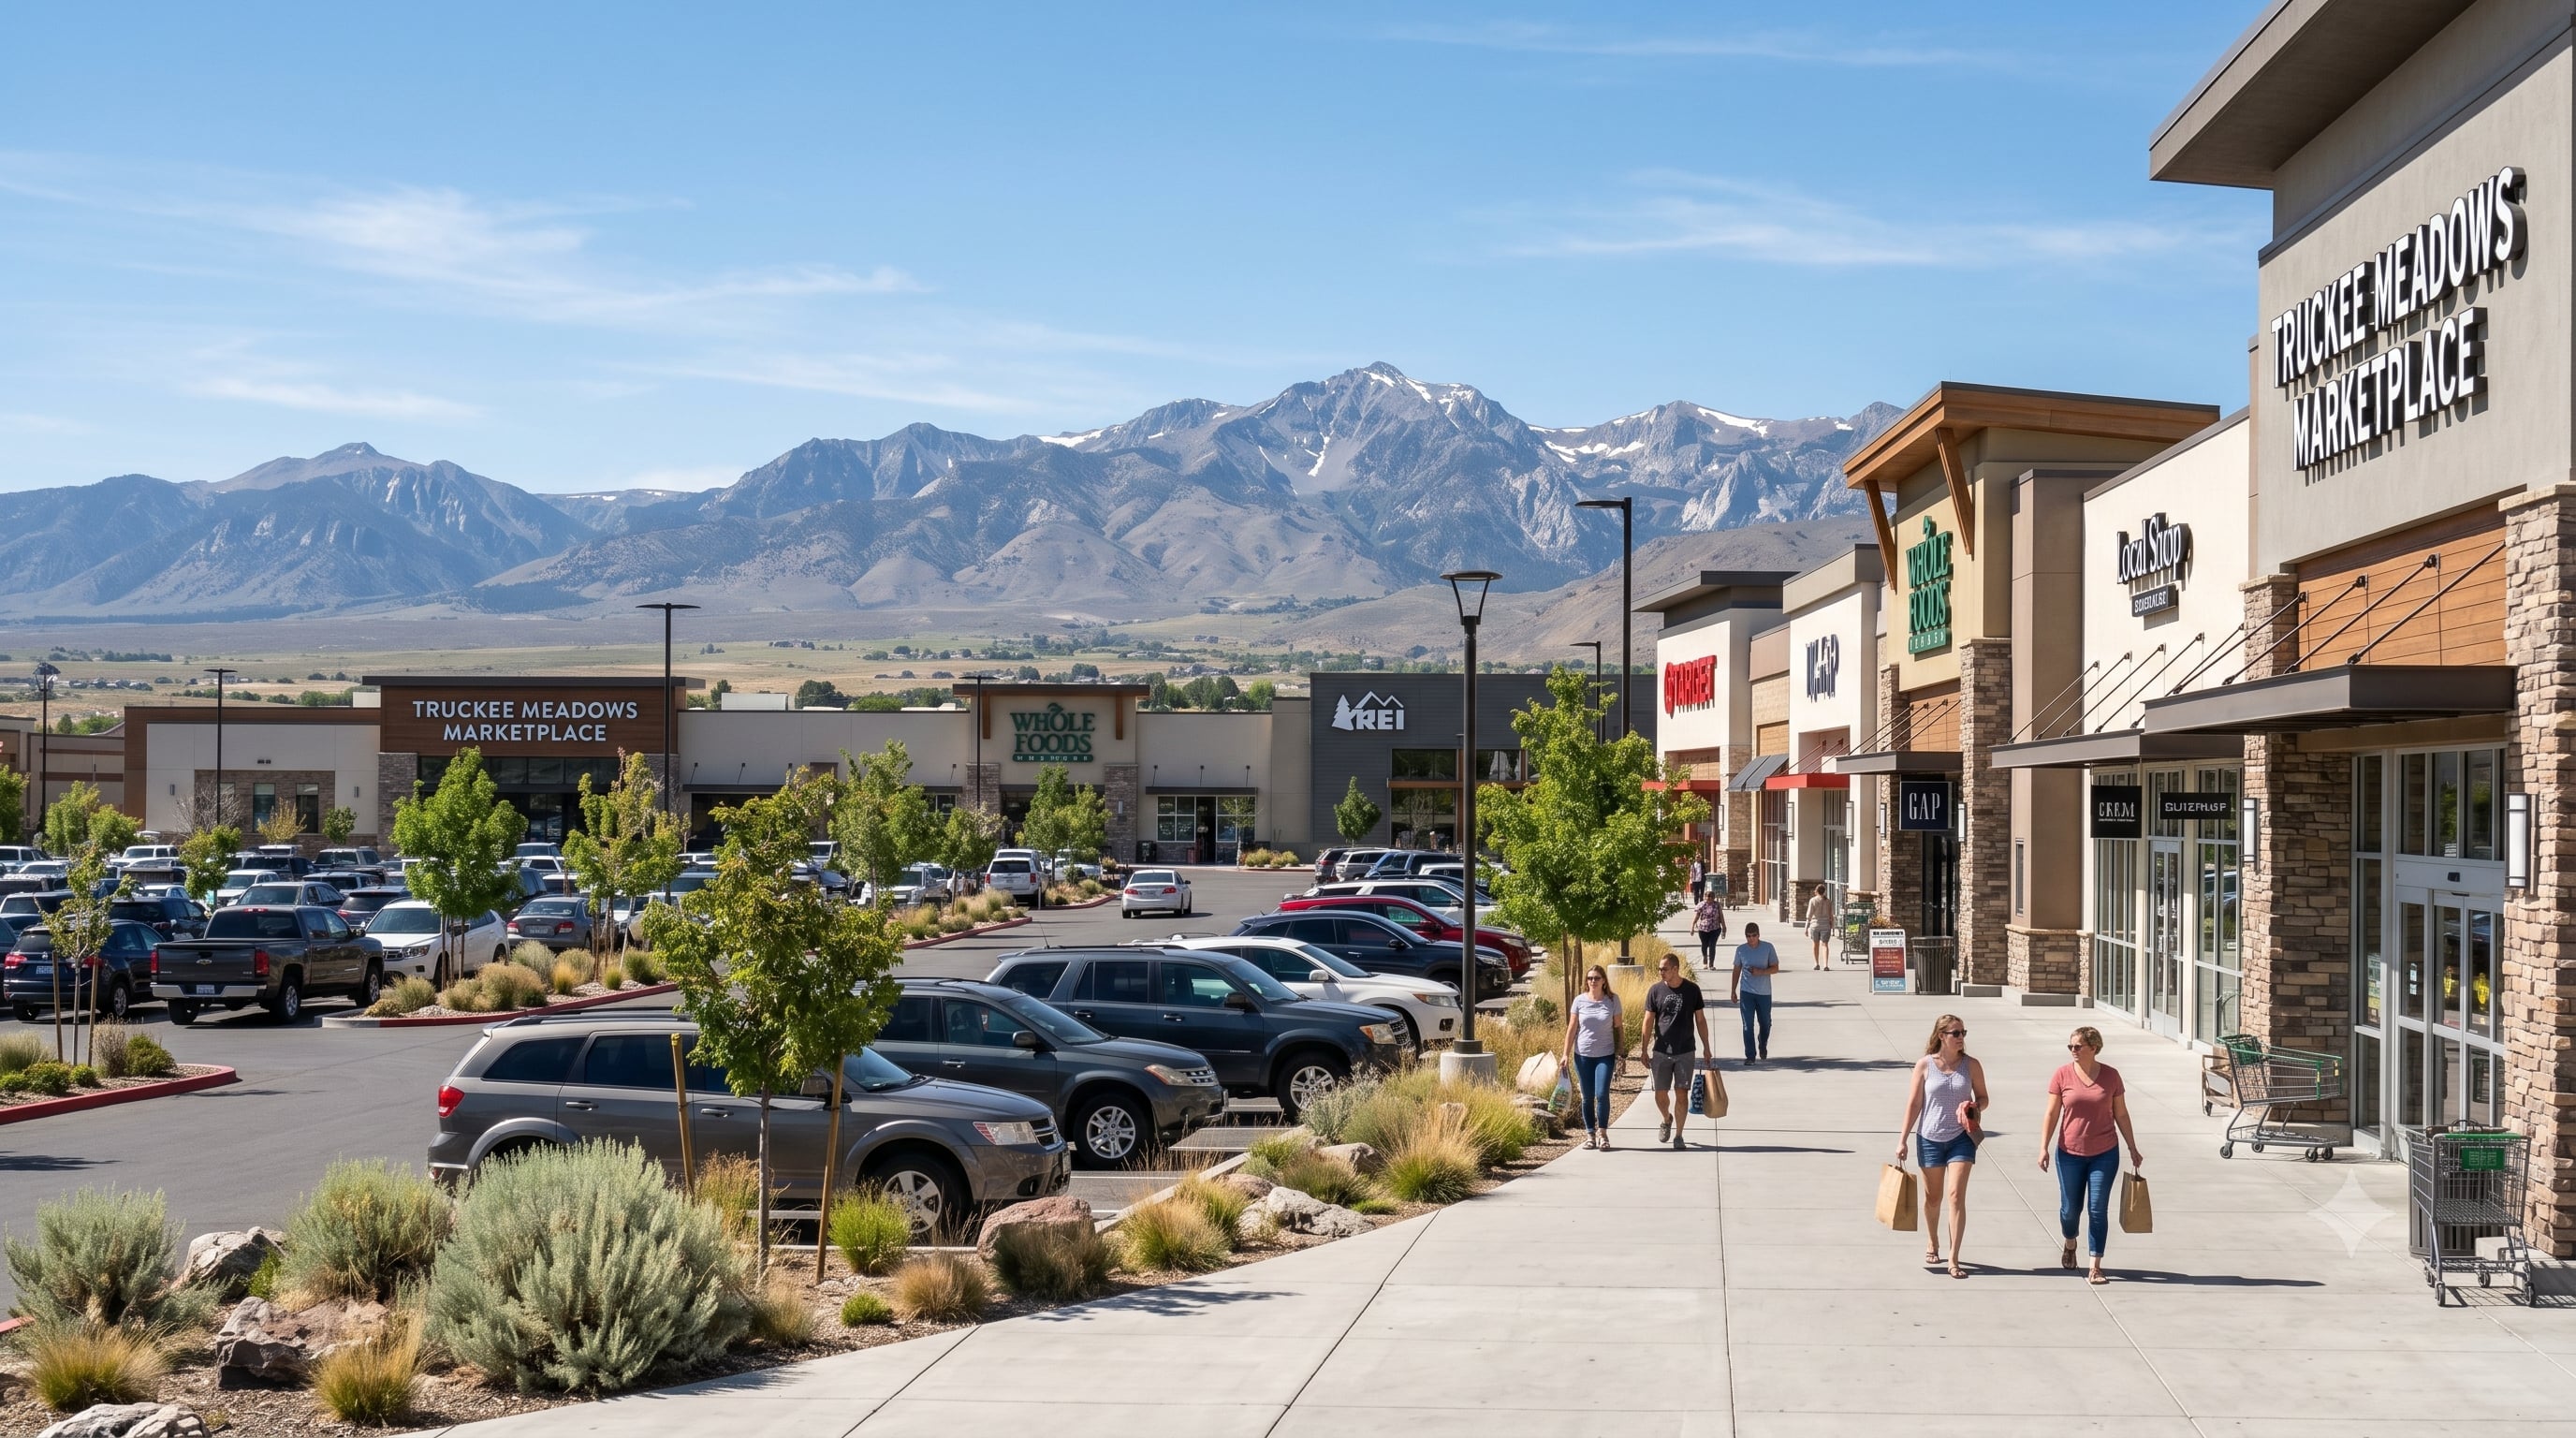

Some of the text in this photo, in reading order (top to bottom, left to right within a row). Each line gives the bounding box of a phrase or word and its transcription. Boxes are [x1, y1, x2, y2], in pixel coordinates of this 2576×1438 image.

[2270, 167, 2523, 389] TRUCKEE MEADOWS
[2293, 307, 2483, 472] MARKETPLACE
[1906, 532, 1950, 590] WHOLE
[1909, 581, 1948, 635] FOODS
[1673, 655, 1716, 708] TARGET
[412, 700, 638, 720] TRUCKEE MEADOWS
[1009, 712, 1096, 732] WHOLE
[1355, 709, 1405, 730] REI
[443, 724, 607, 742] MARKETPLACE
[1014, 733, 1092, 754] FOODS
[1909, 792, 1941, 820] GAP
